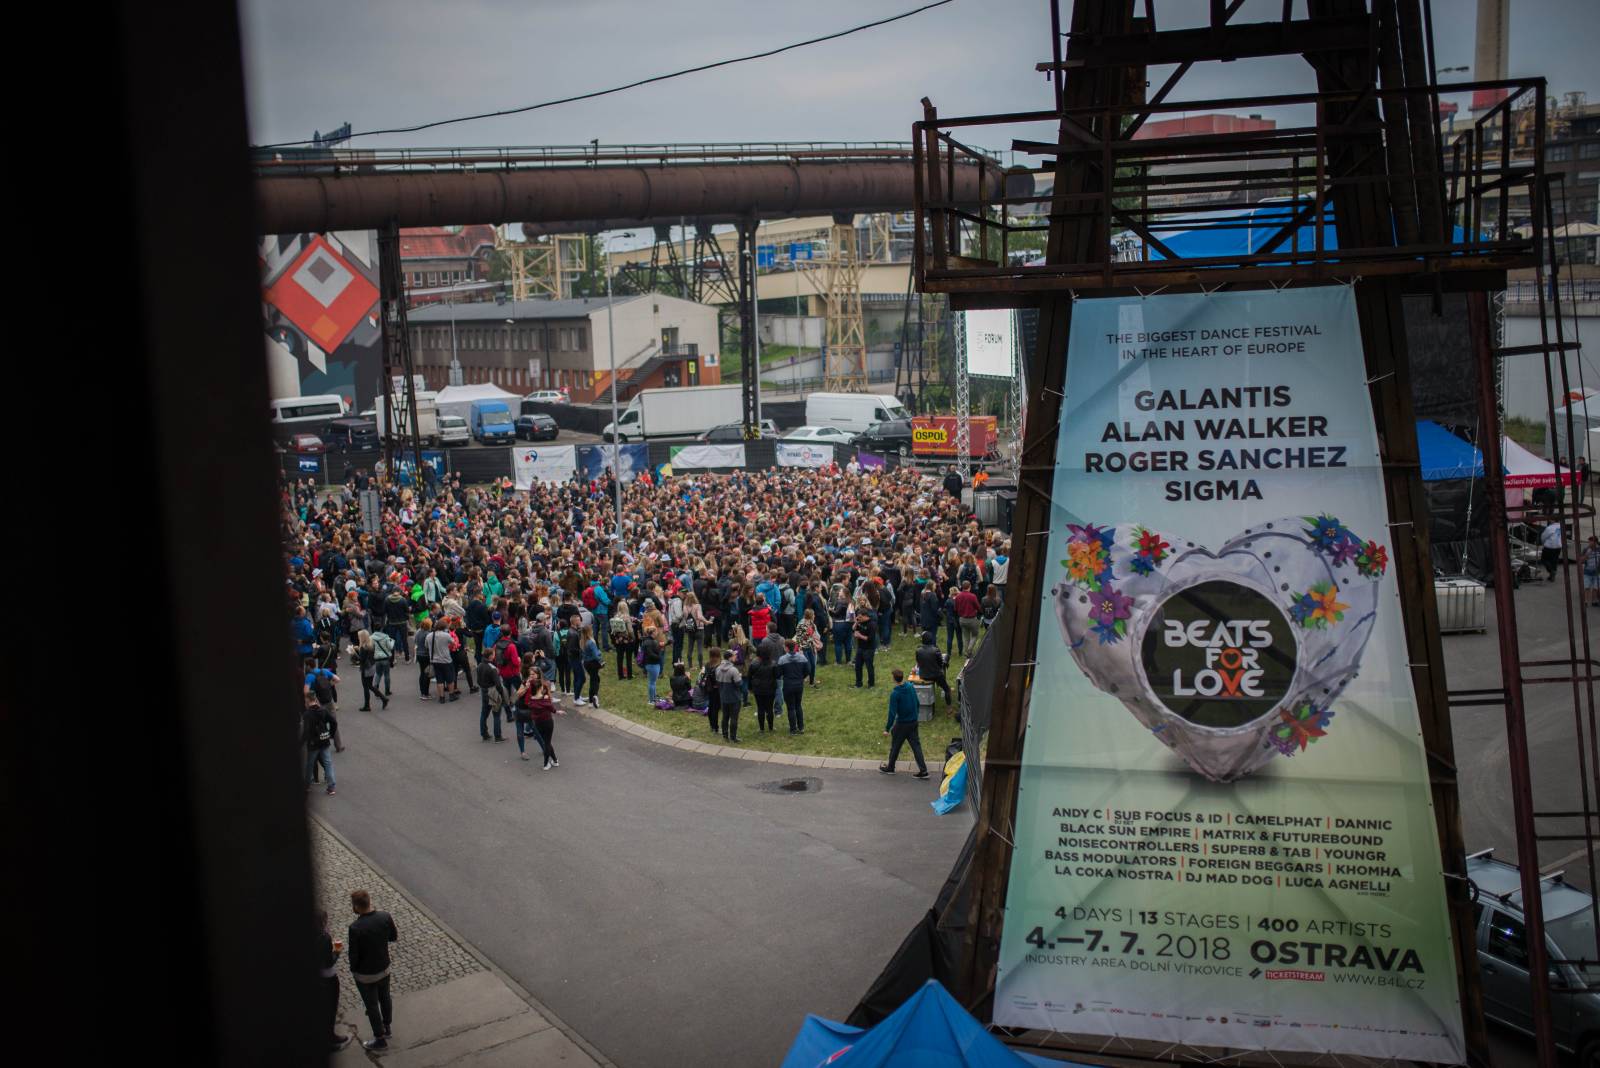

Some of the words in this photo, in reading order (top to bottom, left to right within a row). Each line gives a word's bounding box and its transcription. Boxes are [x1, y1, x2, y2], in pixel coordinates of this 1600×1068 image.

[1106, 333, 1132, 344] THE
[1137, 330, 1196, 343] BIGGEST
[1201, 328, 1250, 340] DANCE
[1254, 325, 1322, 338] FESTIVAL
[1122, 350, 1136, 360] IN
[1141, 348, 1167, 359] THE
[1172, 346, 1218, 358] HEART
[1223, 344, 1242, 356] OF
[1247, 342, 1306, 355] EUROPE
[1134, 385, 1292, 412] GALANTIS
[915, 431, 945, 441] OSPOL
[1101, 420, 1185, 443] ALAN
[1194, 415, 1329, 440] WALKER
[1085, 450, 1189, 473] ROGER
[1197, 446, 1348, 471] SANCHEZ
[1165, 479, 1264, 501] SIGMA
[1164, 619, 1273, 648] BEATS
[1206, 648, 1260, 670] FOR
[1173, 668, 1265, 697] LOVE
[1052, 808, 1090, 819] ANDY
[1093, 809, 1103, 819] C
[1114, 810, 1142, 821] SUB
[1145, 811, 1192, 823] FOCUS
[1195, 813, 1205, 823] &
[1208, 814, 1223, 824] ID
[1235, 814, 1323, 828] CAMELPHAT
[1335, 818, 1393, 831] DANNIC
[1060, 823, 1105, 835] BLACK
[1108, 825, 1136, 836] SUN
[1140, 826, 1191, 838] EMPIRE
[1203, 829, 1255, 840] MATRIX
[1259, 831, 1269, 841] &
[1273, 832, 1384, 846] FUTUREBOUND
[1058, 837, 1199, 853] NOISECONTROLLERS
[1211, 844, 1266, 856] SUPER8
[1269, 846, 1279, 856] &
[1283, 847, 1311, 858] TAB
[1324, 849, 1387, 862] YOUNGR
[1045, 850, 1080, 862] BASS
[1083, 852, 1177, 866] MODULATORS
[1189, 858, 1251, 870] FOREIGN
[1254, 860, 1324, 874] BEGGARS
[1335, 864, 1402, 878] KHOMHA
[1055, 865, 1072, 876] LA
[1075, 867, 1114, 878] COKA
[1118, 869, 1174, 881] NOSTRA
[1186, 872, 1202, 883] DJ
[1206, 874, 1237, 884] MAD
[1242, 875, 1273, 885] DOG
[1285, 876, 1324, 889] LUCA
[1328, 879, 1391, 892] AGNELLI
[1054, 906, 1067, 920] 4
[1073, 906, 1123, 922] DAYS
[1138, 911, 1158, 925] 13
[1164, 912, 1240, 930] STAGES
[1257, 917, 1299, 933] 400
[1305, 919, 1392, 939] ARTISTS
[1156, 933, 1231, 961] 2018
[1250, 940, 1425, 973] OSTRAVA
[1025, 954, 1088, 967] INDUSTRY
[1091, 957, 1126, 969] AREA
[1130, 959, 1170, 972] DOLNÍ
[1266, 970, 1324, 981] TICKETSTREAM
[1333, 972, 1425, 990] WWW.B4L.CZ
